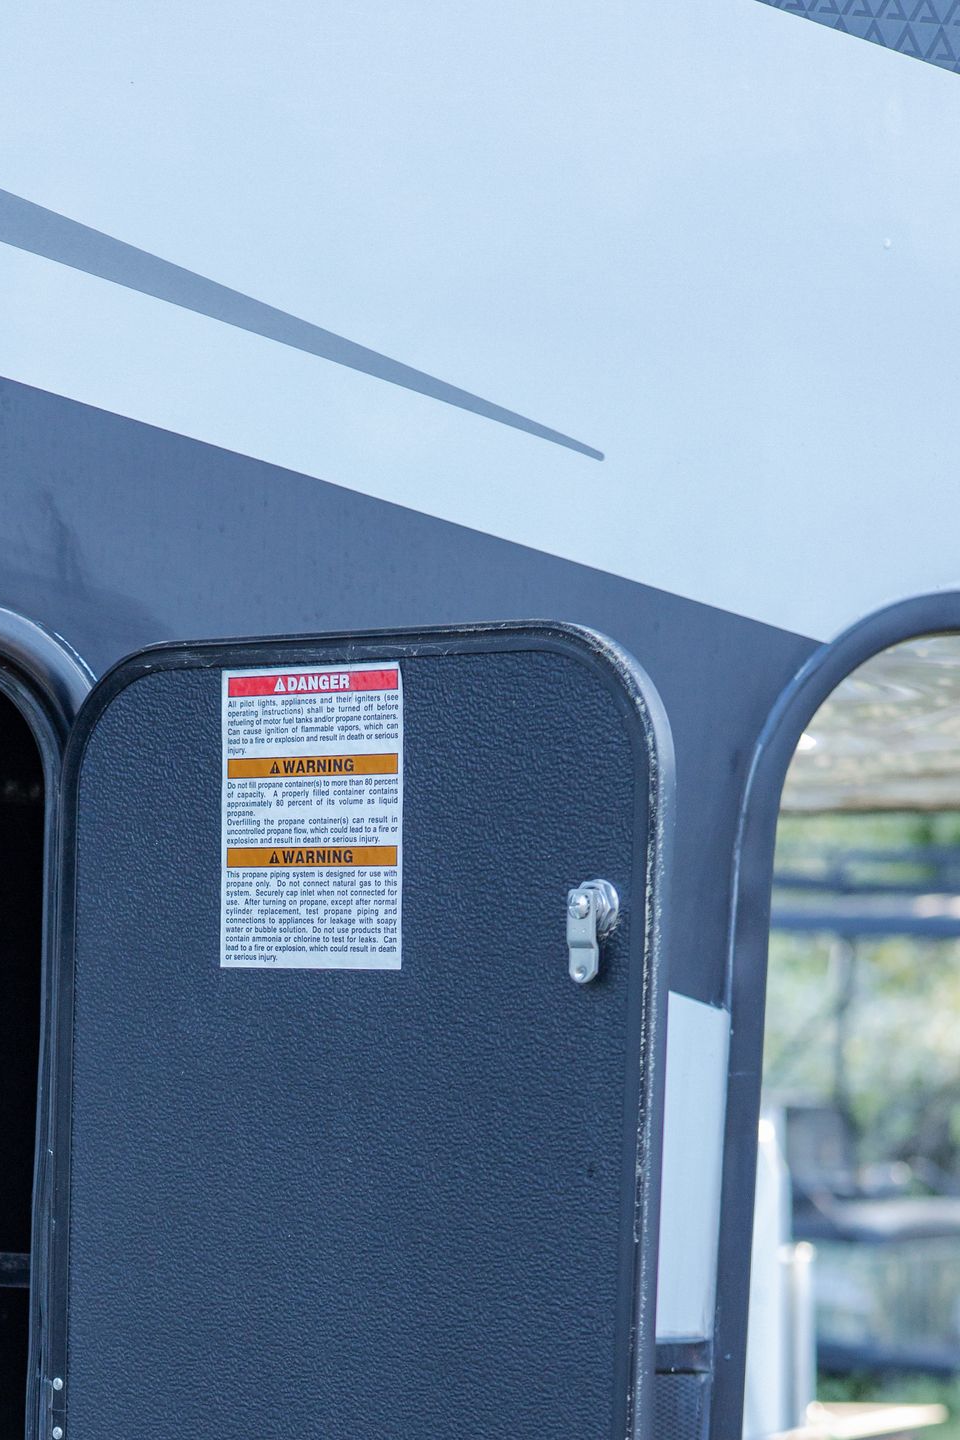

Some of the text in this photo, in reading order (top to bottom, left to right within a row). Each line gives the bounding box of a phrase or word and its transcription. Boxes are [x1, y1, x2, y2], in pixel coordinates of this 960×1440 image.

[287, 674, 350, 692] DANGER
[240, 700, 255, 708] pilot
[258, 700, 278, 708] lights,
[281, 698, 317, 706] appliances
[355, 696, 381, 706] igniters
[384, 694, 399, 702] (see
[262, 706, 304, 717] instructions)
[265, 727, 289, 736] ignition
[227, 747, 247, 755] injury.
[283, 758, 354, 774] WARNING
[284, 780, 322, 788] container(s)
[378, 797, 398, 805] liquid
[359, 835, 380, 844] injury.
[282, 850, 353, 864] WARNING
[270, 871, 290, 879] piping
[325, 870, 356, 879] designed
[357, 908, 379, 916] piping
[258, 954, 278, 962] injury.
